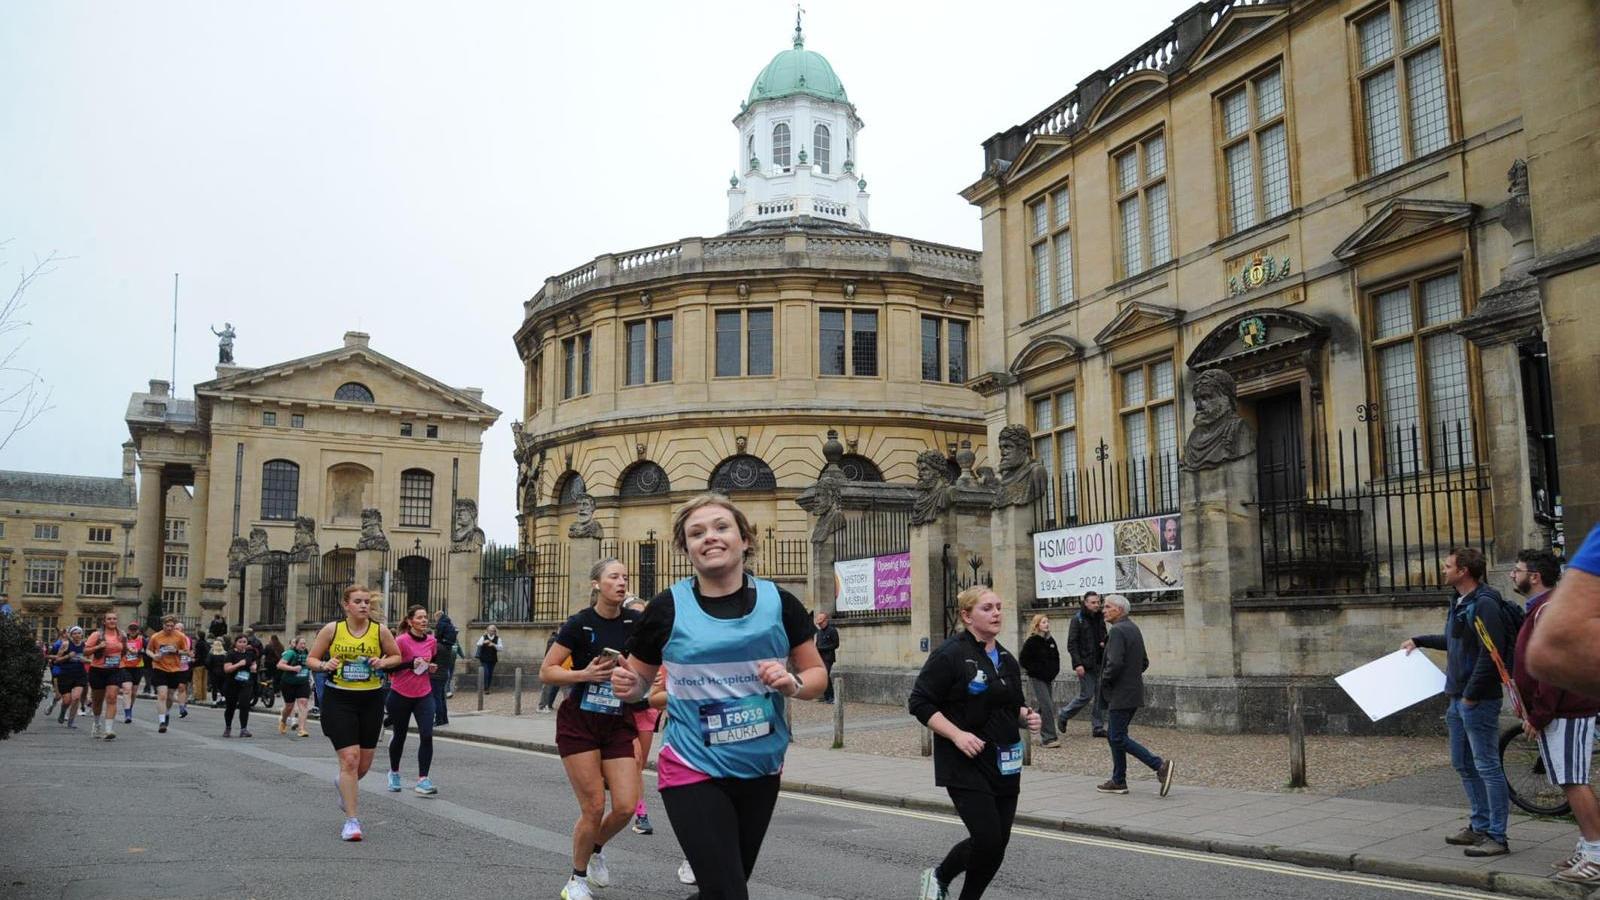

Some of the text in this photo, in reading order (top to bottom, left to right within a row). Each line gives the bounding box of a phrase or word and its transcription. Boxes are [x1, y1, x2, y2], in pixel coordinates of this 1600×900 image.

[1039, 533, 1103, 558] HSM@100
[877, 560, 899, 573] Opening
[844, 573, 868, 585] HISTORY
[1040, 579, 1063, 591] 1924
[1079, 575, 1104, 588] 2024
[844, 595, 869, 606] MUSEUM
[673, 675, 705, 687] xford
[716, 724, 758, 743] LAURA
